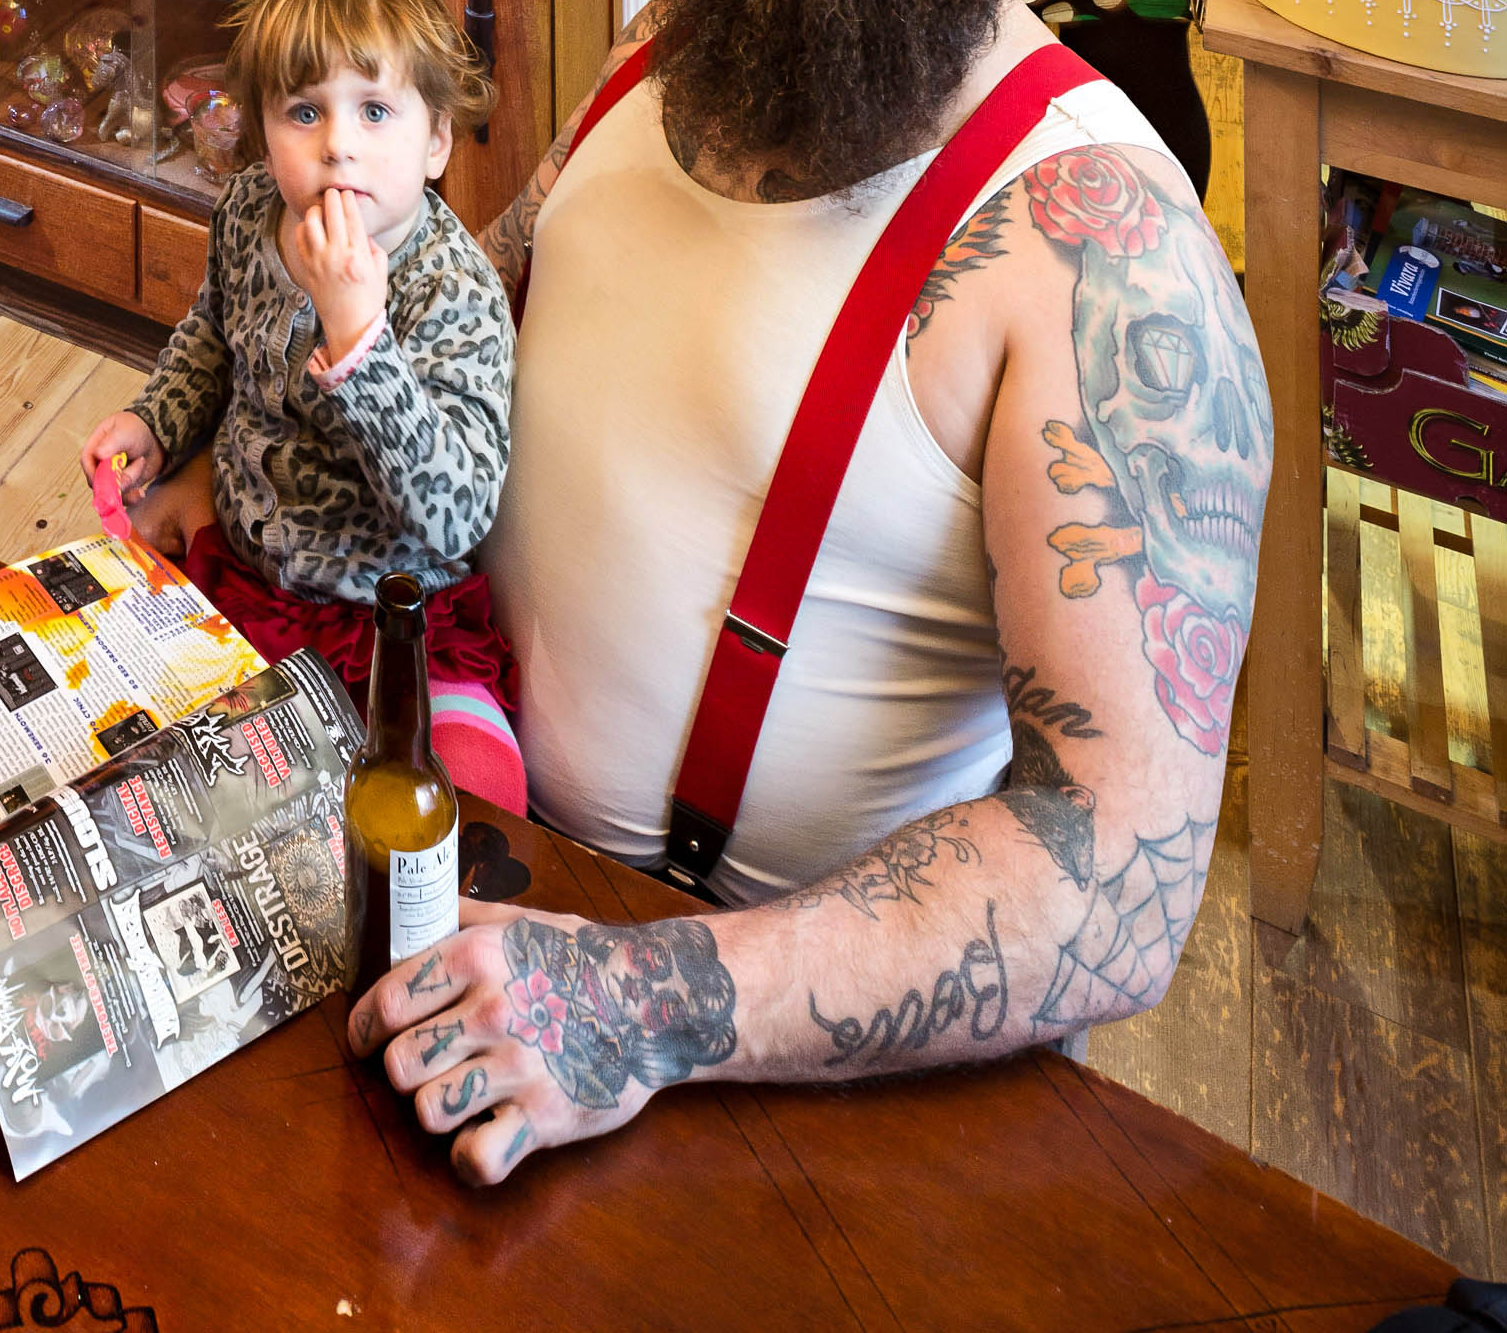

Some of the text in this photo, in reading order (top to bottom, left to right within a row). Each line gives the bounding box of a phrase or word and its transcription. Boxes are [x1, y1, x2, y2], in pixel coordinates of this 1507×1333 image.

[1390, 261, 1420, 298] Vivara
[1408, 407, 1507, 489] G
[13, 710, 44, 751] BEHEMOTH
[239, 720, 282, 788] DISGUISED
[252, 714, 292, 780] VULTURES
[113, 779, 148, 836] DIGITAL
[127, 773, 173, 860] RESISTANCE
[396, 856, 428, 875] Pale
[7, 915, 27, 939] NO
[210, 897, 241, 948] ENDLESS
[230, 828, 310, 972] DESTRAGE
